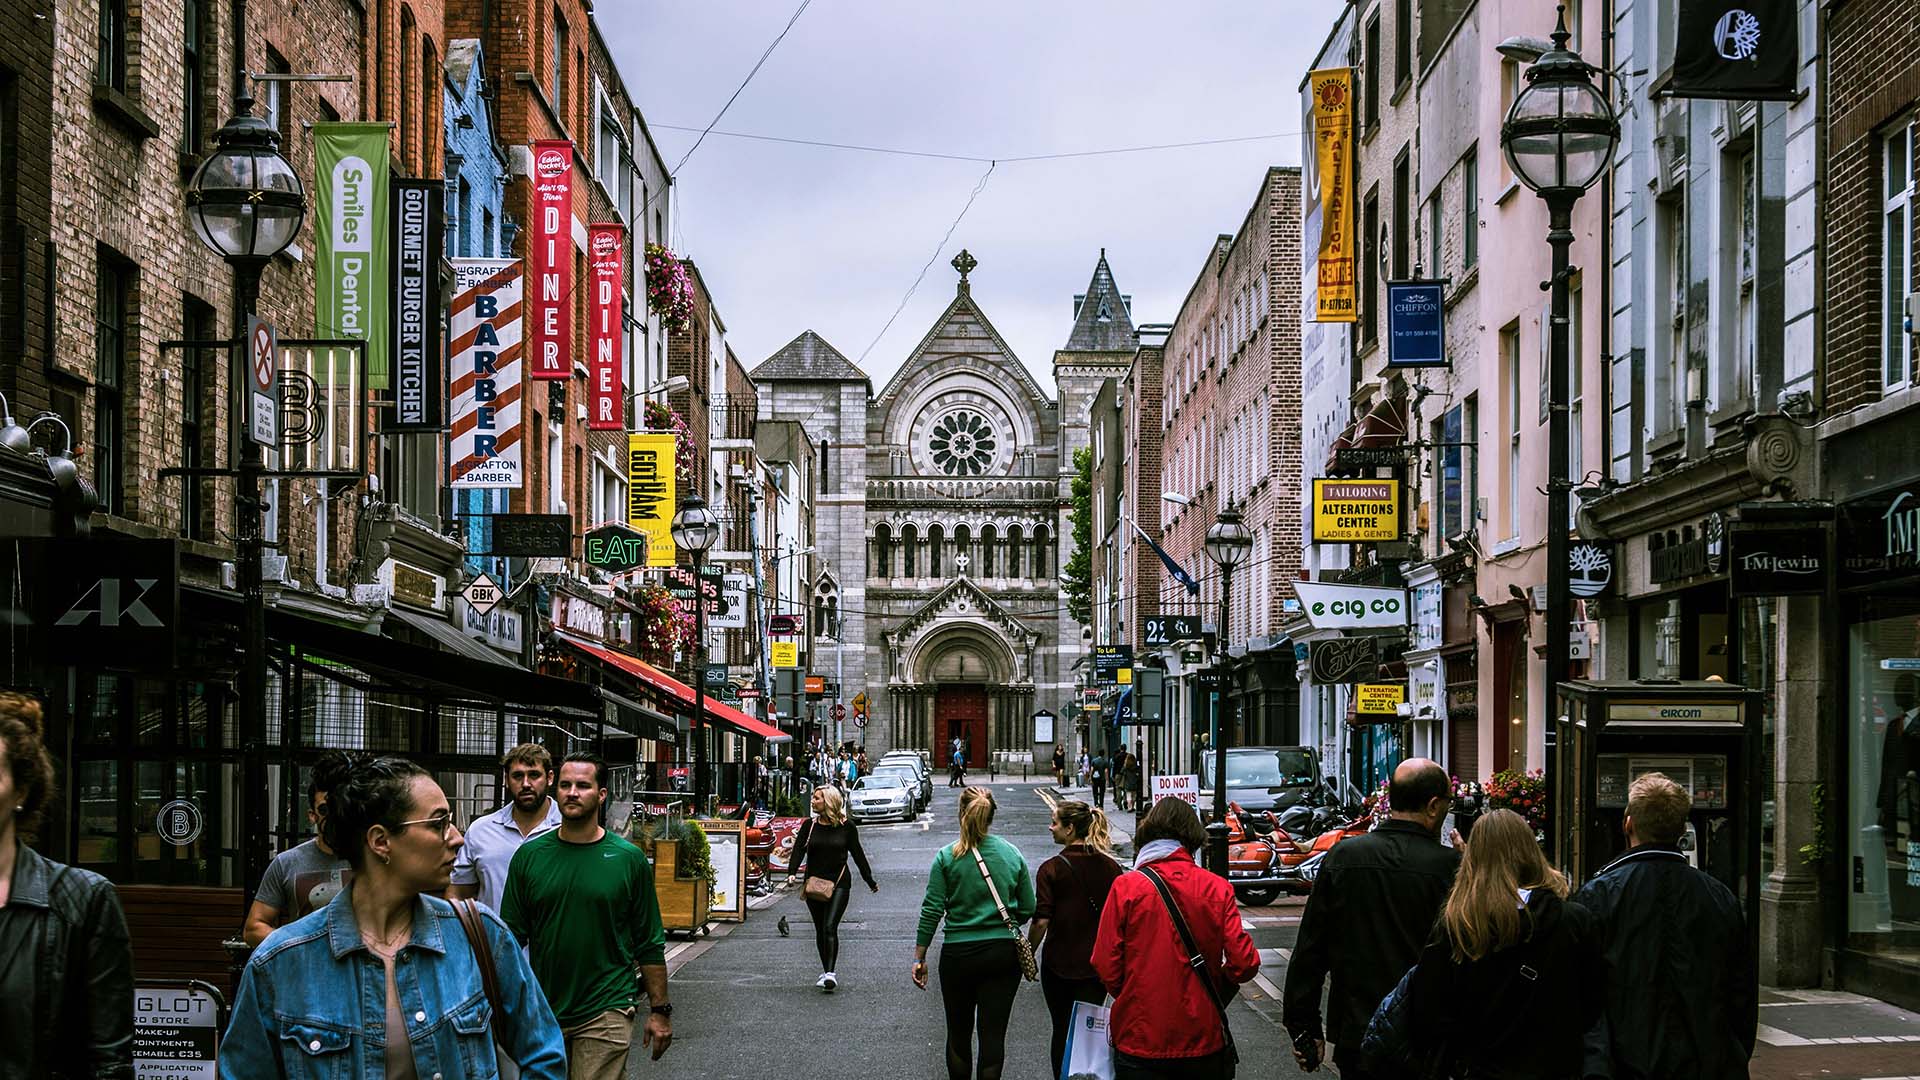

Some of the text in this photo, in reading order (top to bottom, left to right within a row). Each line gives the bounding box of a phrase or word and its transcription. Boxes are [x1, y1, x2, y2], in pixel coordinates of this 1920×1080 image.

[1331, 141, 1342, 254] ALTERATION
[341, 168, 363, 337] Smiles Dental
[457, 266, 466, 286] THE
[466, 266, 518, 276] GRAFTON
[1320, 262, 1351, 282] CENTRE
[468, 279, 513, 289] BARBER
[543, 206, 560, 369] DINER
[402, 188, 421, 423] GOURMET BURGER KITCHEN
[1394, 303, 1437, 313] CHIFFON
[599, 280, 613, 421] DINER
[473, 295, 500, 458] BARBER
[1340, 450, 1403, 464] RESTAURANT
[466, 461, 517, 470] GRAFTON
[467, 473, 512, 482] BARBER
[631, 450, 668, 520] GOTHAM
[1328, 488, 1387, 498] TAILORING
[1322, 504, 1394, 515] ALTERATIONS
[1337, 517, 1378, 528] CENTRE
[588, 535, 641, 565] EAT
[701, 566, 721, 576] INES
[722, 580, 742, 591] METIC
[472, 589, 494, 600] GBK
[670, 589, 697, 598] SPIRITS
[53, 578, 166, 627] AK
[1311, 602, 1325, 616] e
[1330, 600, 1365, 619] cig
[1370, 598, 1400, 614] co
[706, 671, 725, 680] SO
[830, 707, 847, 716] SOP
[1660, 708, 1702, 718] eircom
[1159, 777, 1189, 789] DO NOT
[171, 810, 190, 836] B
[138, 997, 207, 1012] GLOT
[132, 1016, 190, 1024] RO STORE
